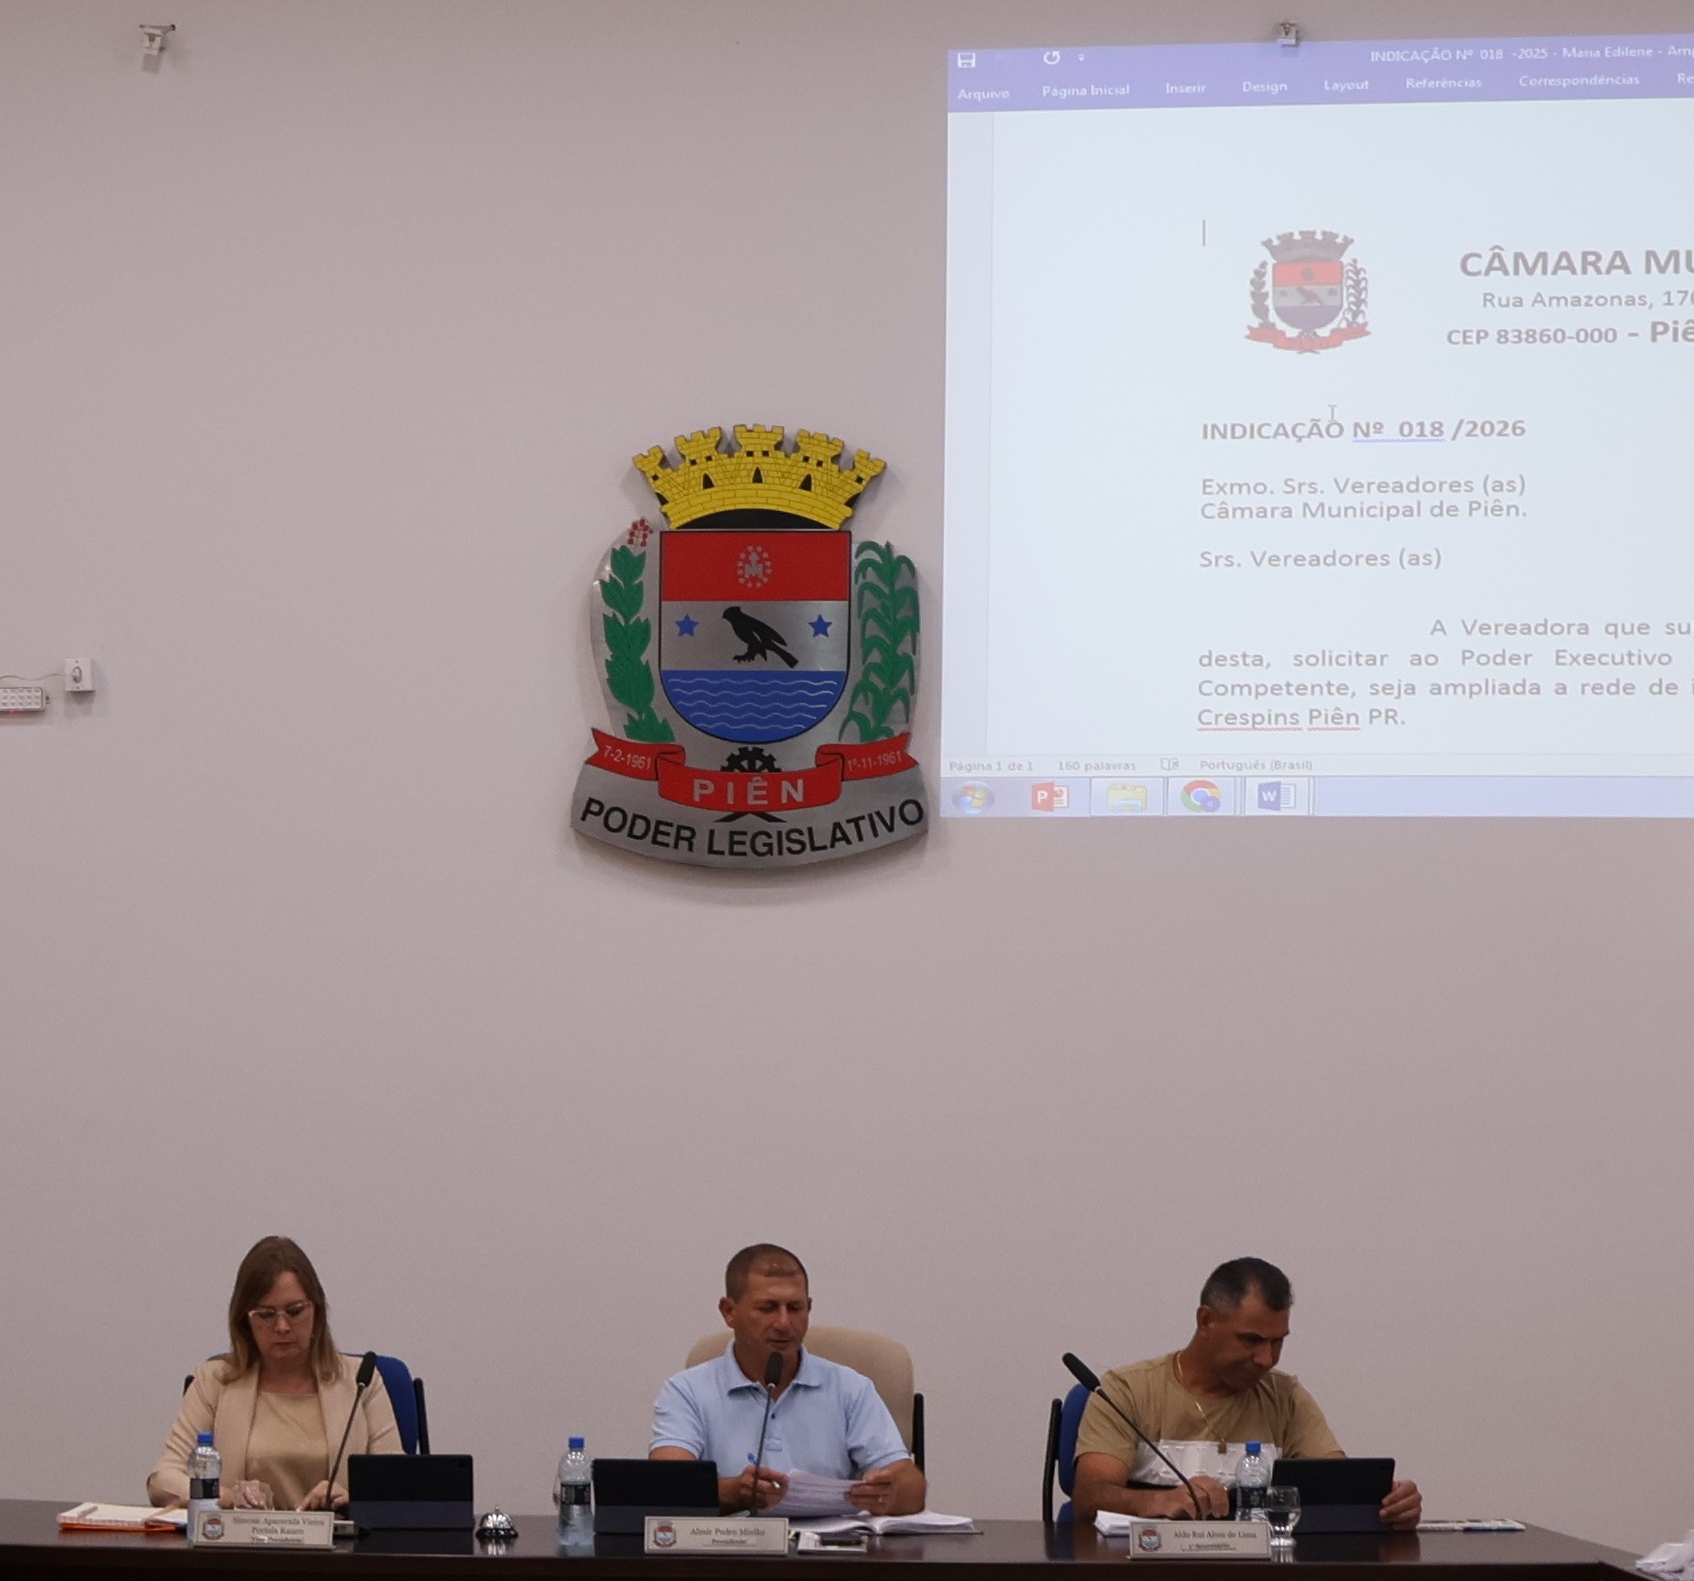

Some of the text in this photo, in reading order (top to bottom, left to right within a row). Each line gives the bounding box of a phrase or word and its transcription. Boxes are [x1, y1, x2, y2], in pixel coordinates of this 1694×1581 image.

[1371, 49, 1452, 64] INDICAÇÃO
[1480, 48, 1504, 60] 018
[1562, 47, 1601, 59] Maria
[1605, 46, 1653, 58] Edilene
[1166, 82, 1207, 94] Inserir
[1242, 81, 1288, 95] Design
[1324, 79, 1370, 93] Layout
[1406, 77, 1482, 90] Referências
[1519, 72, 1641, 90] Correspondências
[957, 88, 1011, 101] Arquivo
[1042, 84, 1130, 99] Página Inicial
[1459, 245, 1633, 277] CÂMARA
[1482, 292, 1524, 309] Rua
[1531, 291, 1654, 310] Amazonas,
[1447, 329, 1489, 346] CEP
[1496, 327, 1618, 345] 83860-000
[1201, 418, 1527, 443] INDICAÇÃO Nº 018 /2026
[1201, 474, 1527, 497] Exmo. Srs. Vereadores (as)
[1200, 499, 1528, 522] Câmara Municipal de Piên.
[1199, 547, 1442, 570] Srs. Vereadores (as)
[1429, 619, 1448, 636] A
[1461, 618, 1590, 636] Vereadora
[1604, 621, 1651, 640] que
[1199, 649, 1272, 670] desta,
[1292, 649, 1389, 668] solicitar
[1409, 652, 1440, 667] ao
[1461, 648, 1533, 667] Poder
[1555, 648, 1673, 667] Executivo
[1197, 679, 1357, 700] Competente,
[1368, 680, 1416, 701] seja
[1429, 679, 1542, 700] ampliada
[1554, 681, 1568, 696] a
[1580, 678, 1636, 696] rede
[1648, 678, 1679, 696] de
[1197, 706, 1407, 729] Crespins Piên PR.
[603, 744, 652, 771] 7-2-1961
[949, 760, 992, 773] Página
[1008, 760, 1023, 771] de
[1027, 760, 1034, 771] 1
[1058, 759, 1137, 773] 160 palavras
[1200, 758, 1313, 773] Português (Brasil)
[692, 776, 805, 805] PIÊN
[580, 796, 924, 857] PODER LEGISLATIVO
